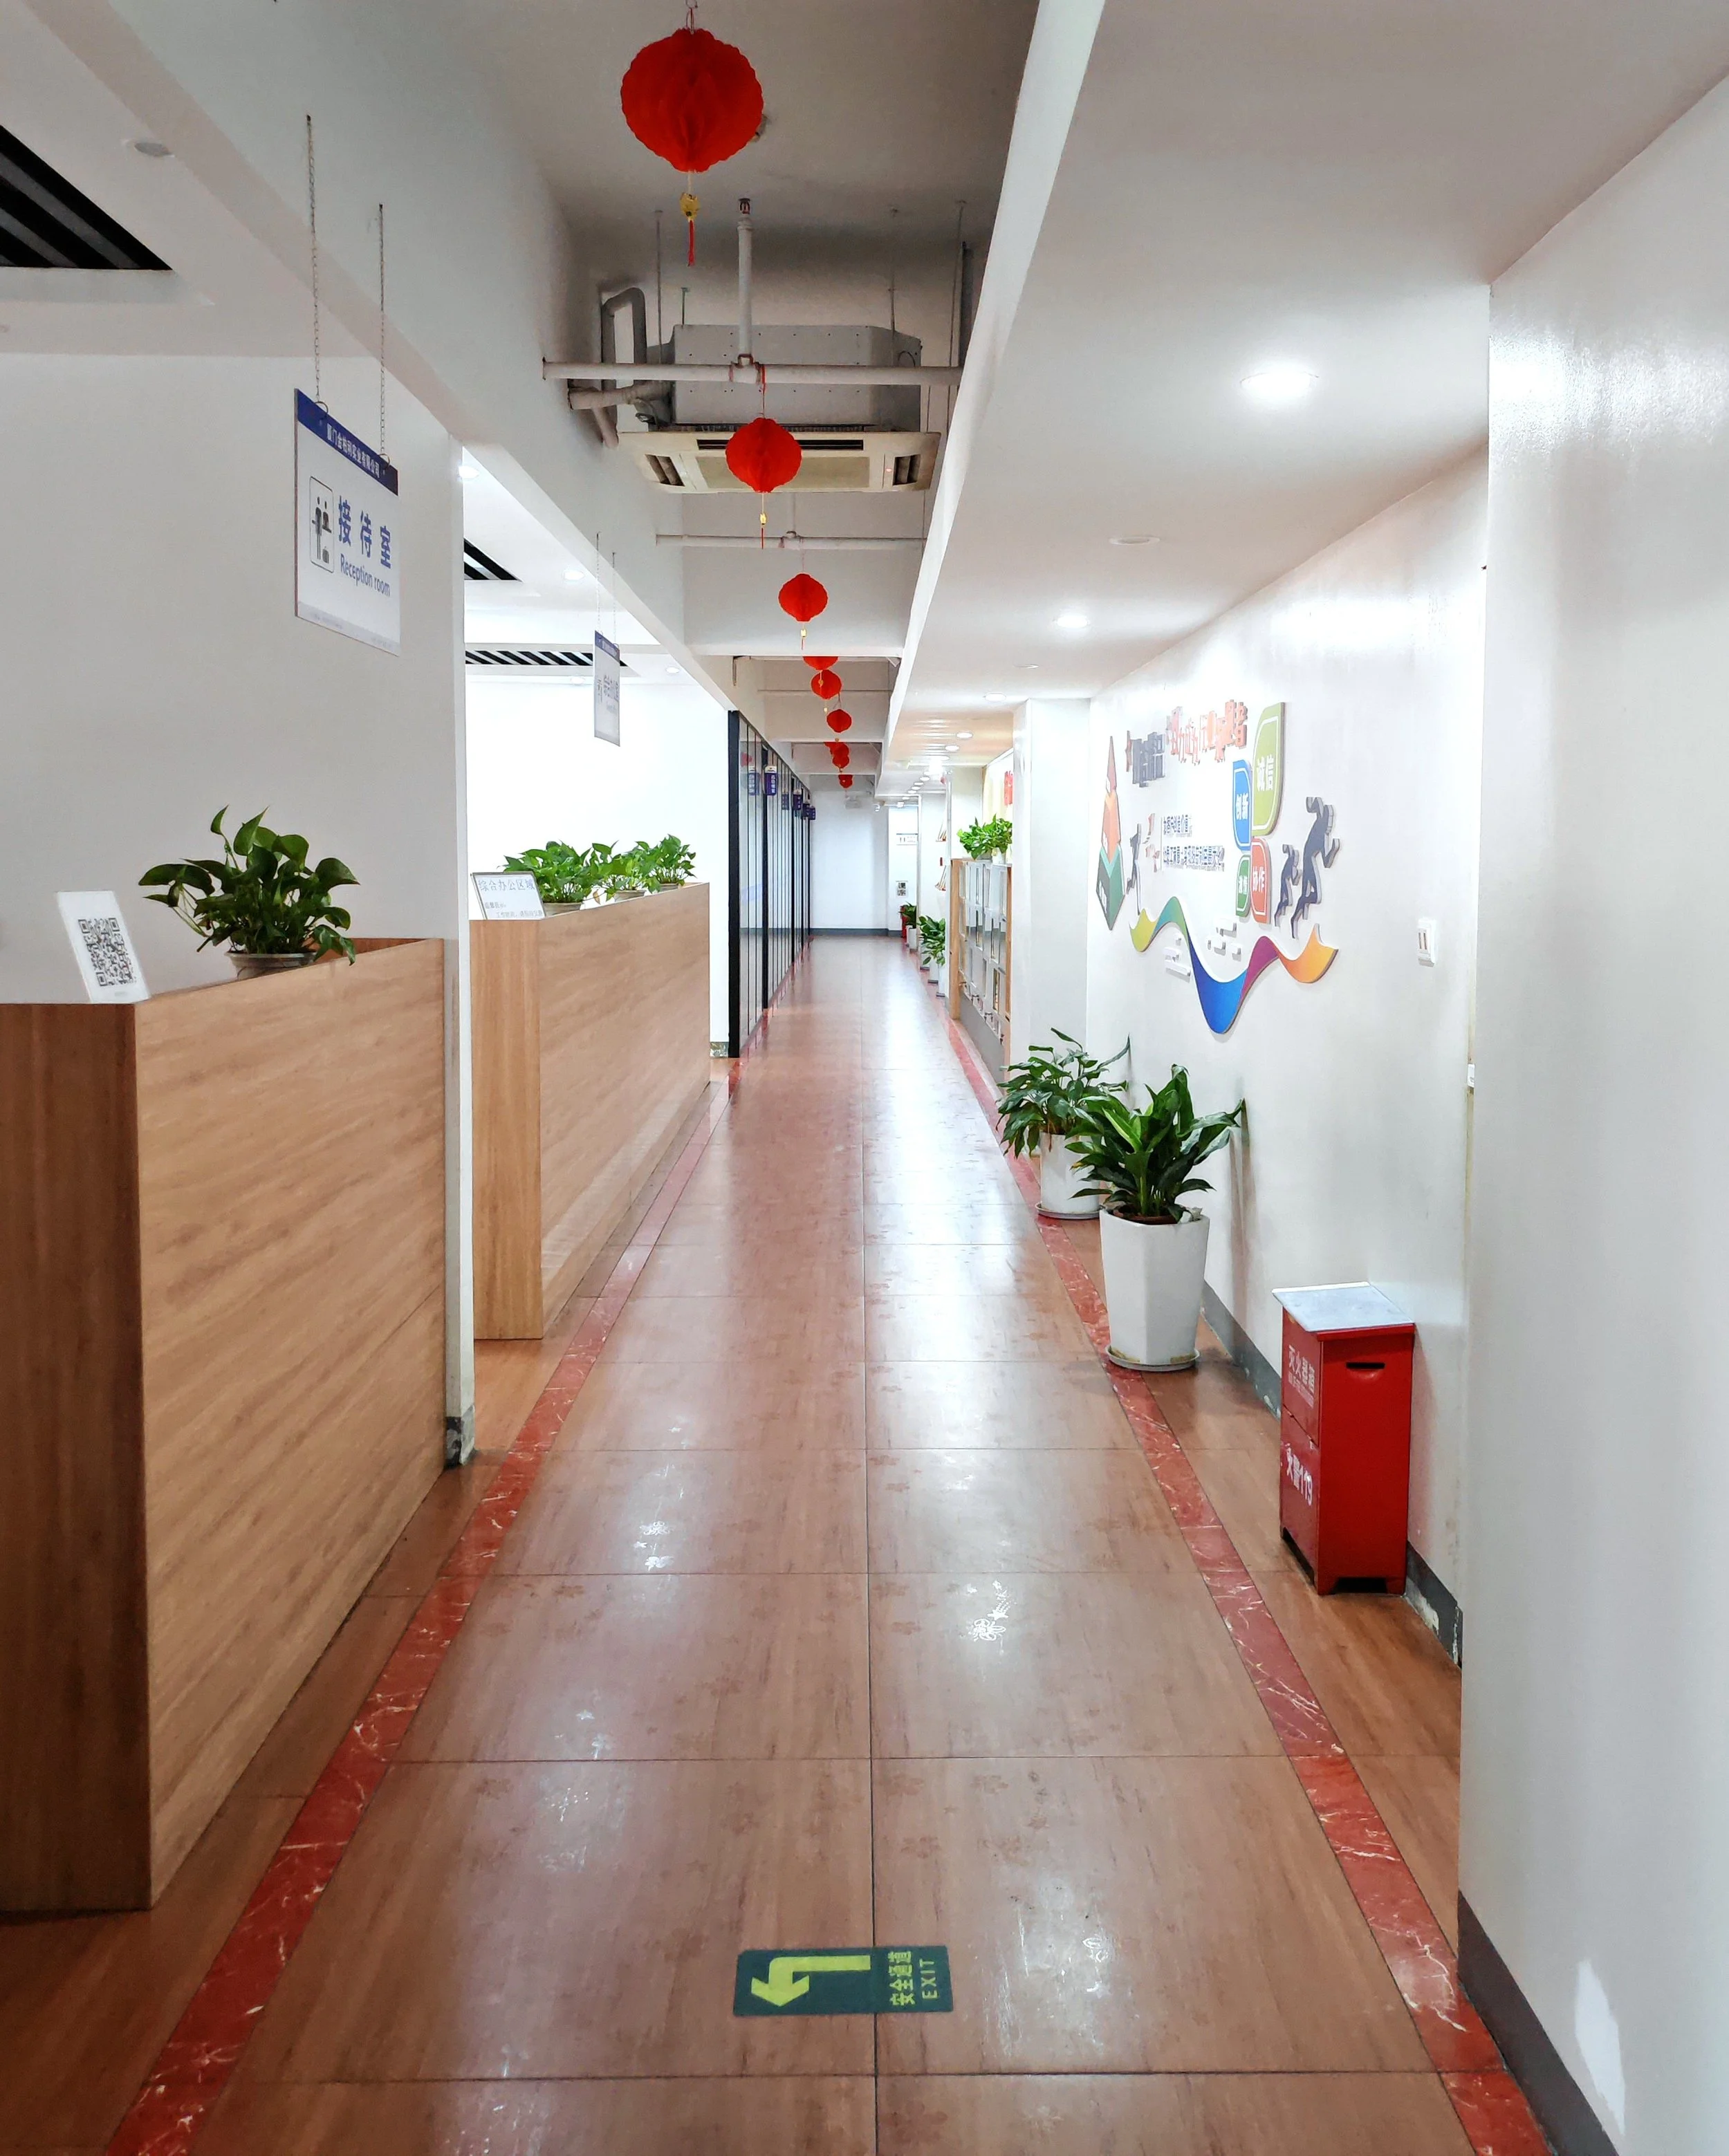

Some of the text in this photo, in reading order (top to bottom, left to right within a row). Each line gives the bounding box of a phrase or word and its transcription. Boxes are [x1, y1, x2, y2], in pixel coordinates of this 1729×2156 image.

[338, 495, 391, 569] 接待室
[340, 553, 391, 597] Reception room
[1257, 754, 1274, 791] 诚信
[1235, 793, 1249, 821] 创新
[478, 879, 535, 892] 综合办公区域
[1252, 866, 1266, 892] 协作
[1288, 1345, 1315, 1394] 灭火器箱
[1286, 1447, 1313, 1507] 火警119
[887, 1951, 915, 2006] 安全通道
[919, 1958, 939, 2000] EXIT
